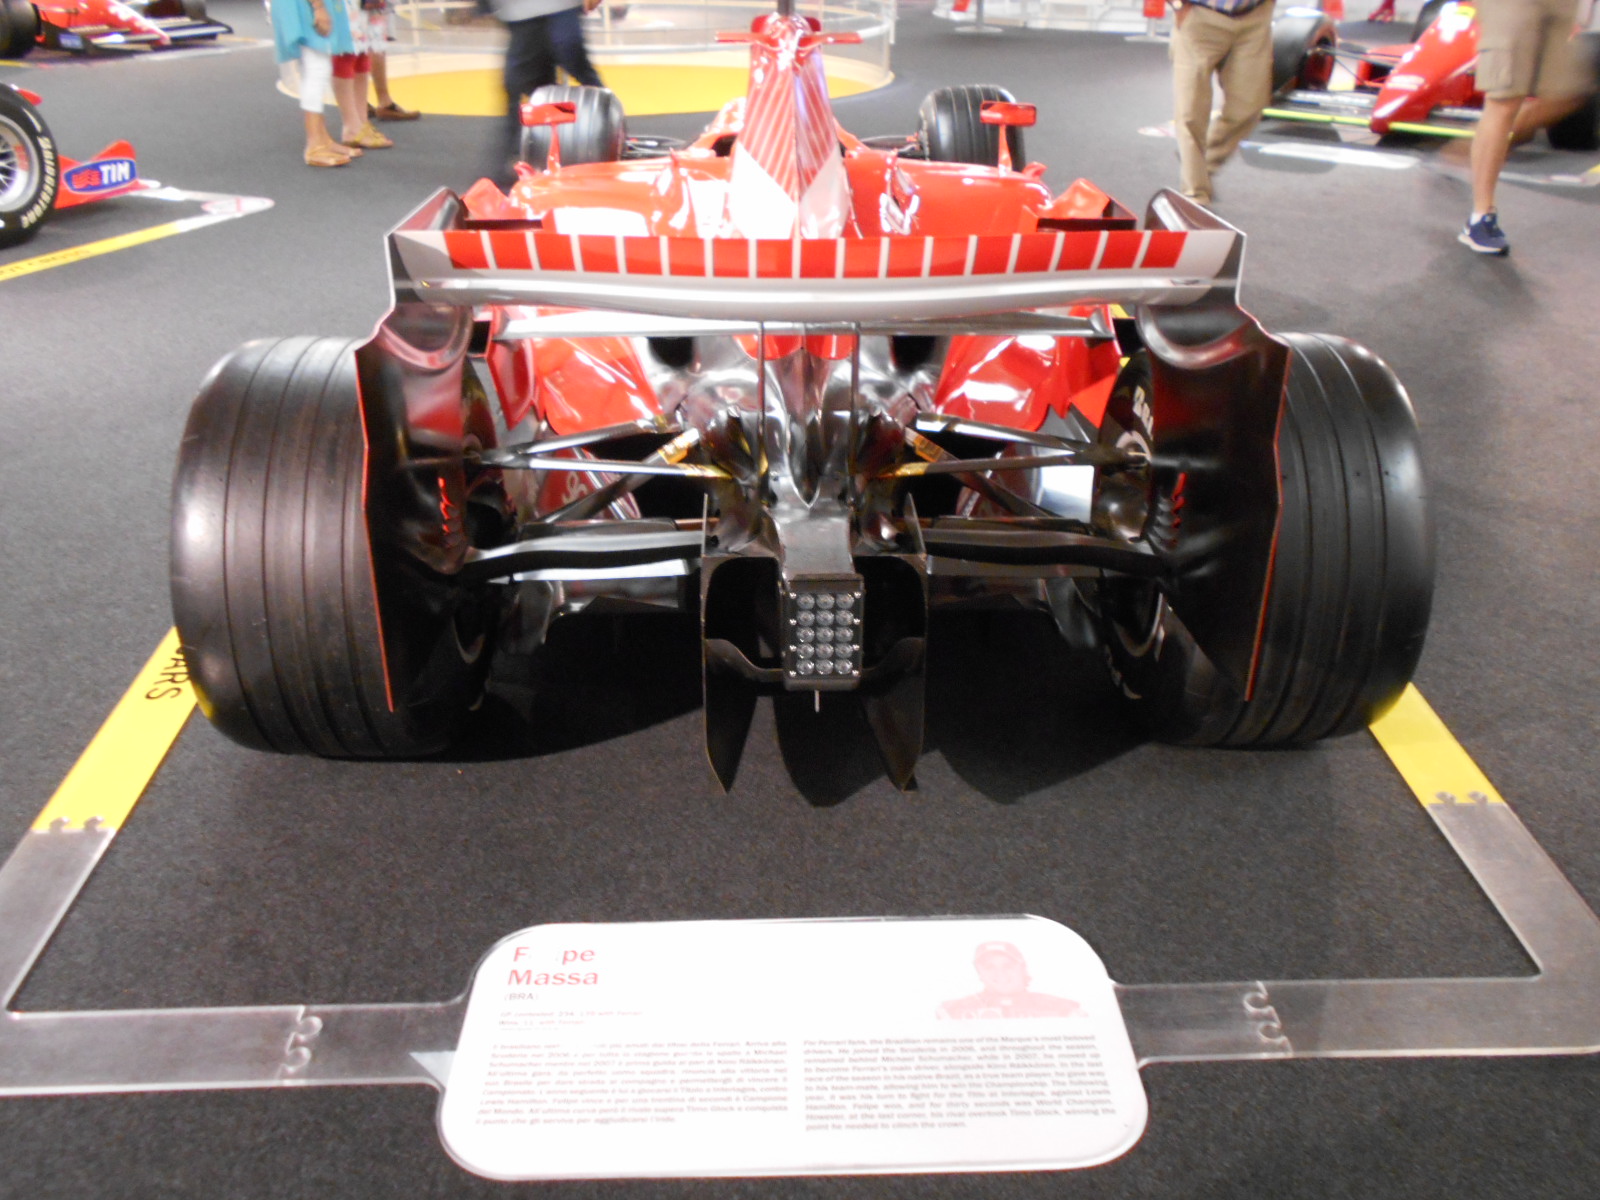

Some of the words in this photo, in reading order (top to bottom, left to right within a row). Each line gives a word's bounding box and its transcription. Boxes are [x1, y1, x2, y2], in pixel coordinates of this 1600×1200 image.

[145, 646, 190, 700] ARS
[513, 946, 596, 965] Fpe
[507, 969, 599, 986] Massa
